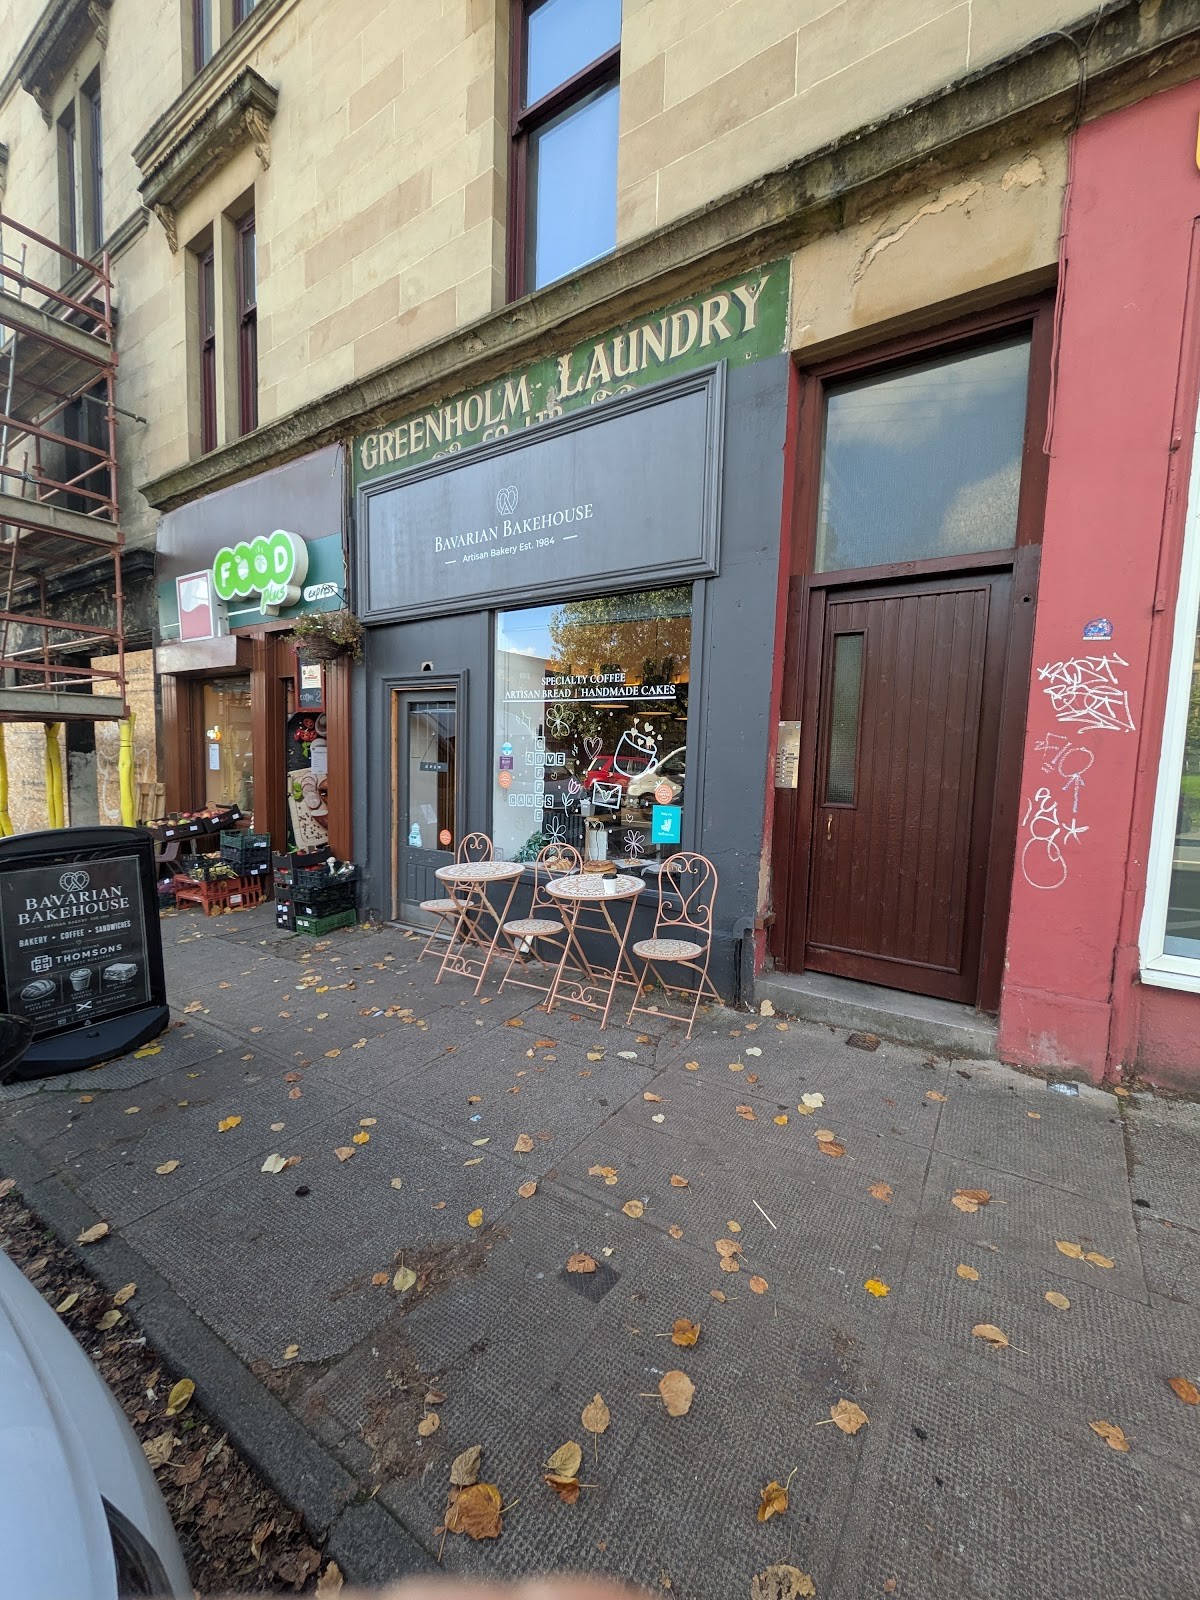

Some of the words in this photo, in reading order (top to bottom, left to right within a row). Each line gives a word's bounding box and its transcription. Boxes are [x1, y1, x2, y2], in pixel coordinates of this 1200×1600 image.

[360, 374, 532, 471] GREENHOLM
[557, 275, 770, 400] LAUNDRY
[435, 526, 499, 553] BAVARIAN
[503, 503, 594, 537] BAKEHOUSE
[462, 551, 489, 564] Artisan
[491, 545, 518, 558] Bakery
[519, 542, 534, 552] Est.
[536, 536, 556, 548] 1984
[220, 545, 289, 589] FOOD
[505, 689, 542, 699] ARTISAN
[542, 688, 571, 698] BREAD
[581, 686, 639, 697] HANDMADE
[640, 684, 676, 696] CAKES
[541, 674, 589, 686] SPECIALTY
[590, 672, 626, 684] COFFEE
[18, 898, 130, 926] BAKEHOUSE
[25, 885, 123, 911] BAVARIAN
[19, 935, 48, 948] BAKERY
[60, 929, 85, 940] COFFEE
[95, 920, 131, 934] SANDWICHES
[56, 943, 123, 964] THOMSONS
